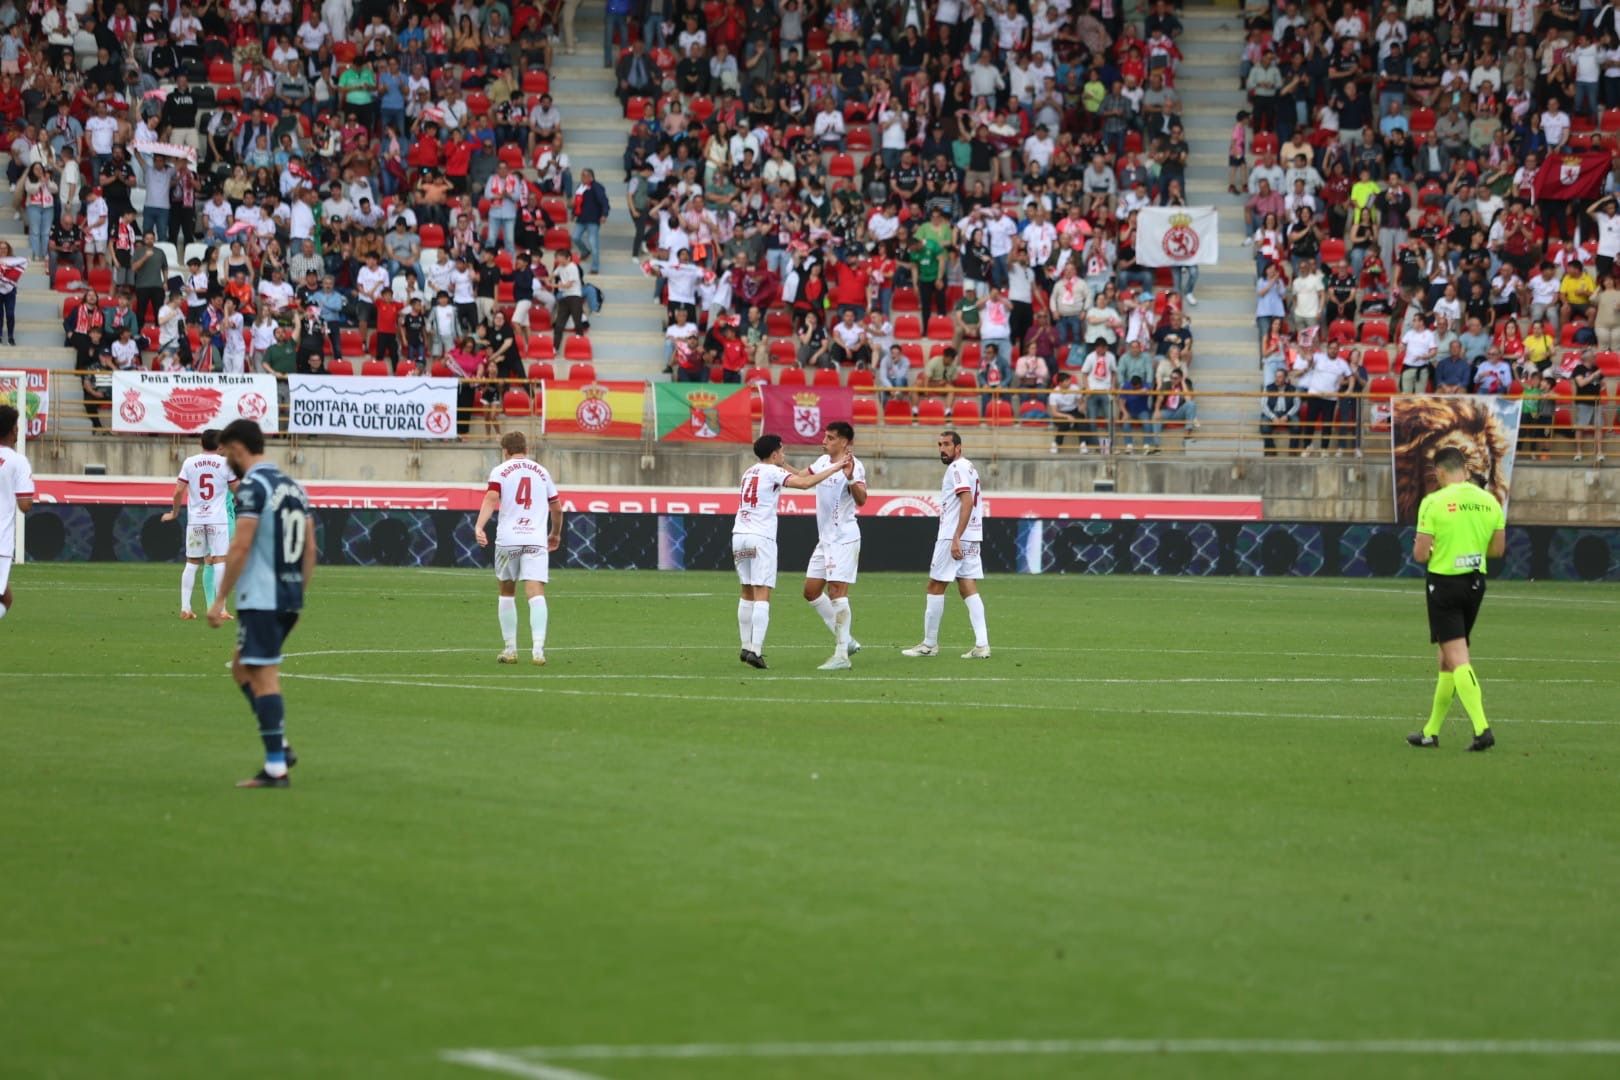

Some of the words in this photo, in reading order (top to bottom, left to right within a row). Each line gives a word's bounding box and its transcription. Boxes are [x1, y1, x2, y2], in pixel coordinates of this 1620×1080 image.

[140, 374, 169, 383] Peña
[173, 374, 214, 384] Toribio
[218, 375, 254, 384] Morán
[294, 399, 358, 414] MONTAÑA
[364, 403, 380, 415] DE
[385, 400, 425, 415] RIAÑO
[294, 412, 323, 427] CON
[329, 414, 347, 428] LA
[353, 415, 425, 431] CULTURAL
[199, 473, 214, 501] 5
[515, 476, 532, 510] 4
[740, 476, 759, 509] 14
